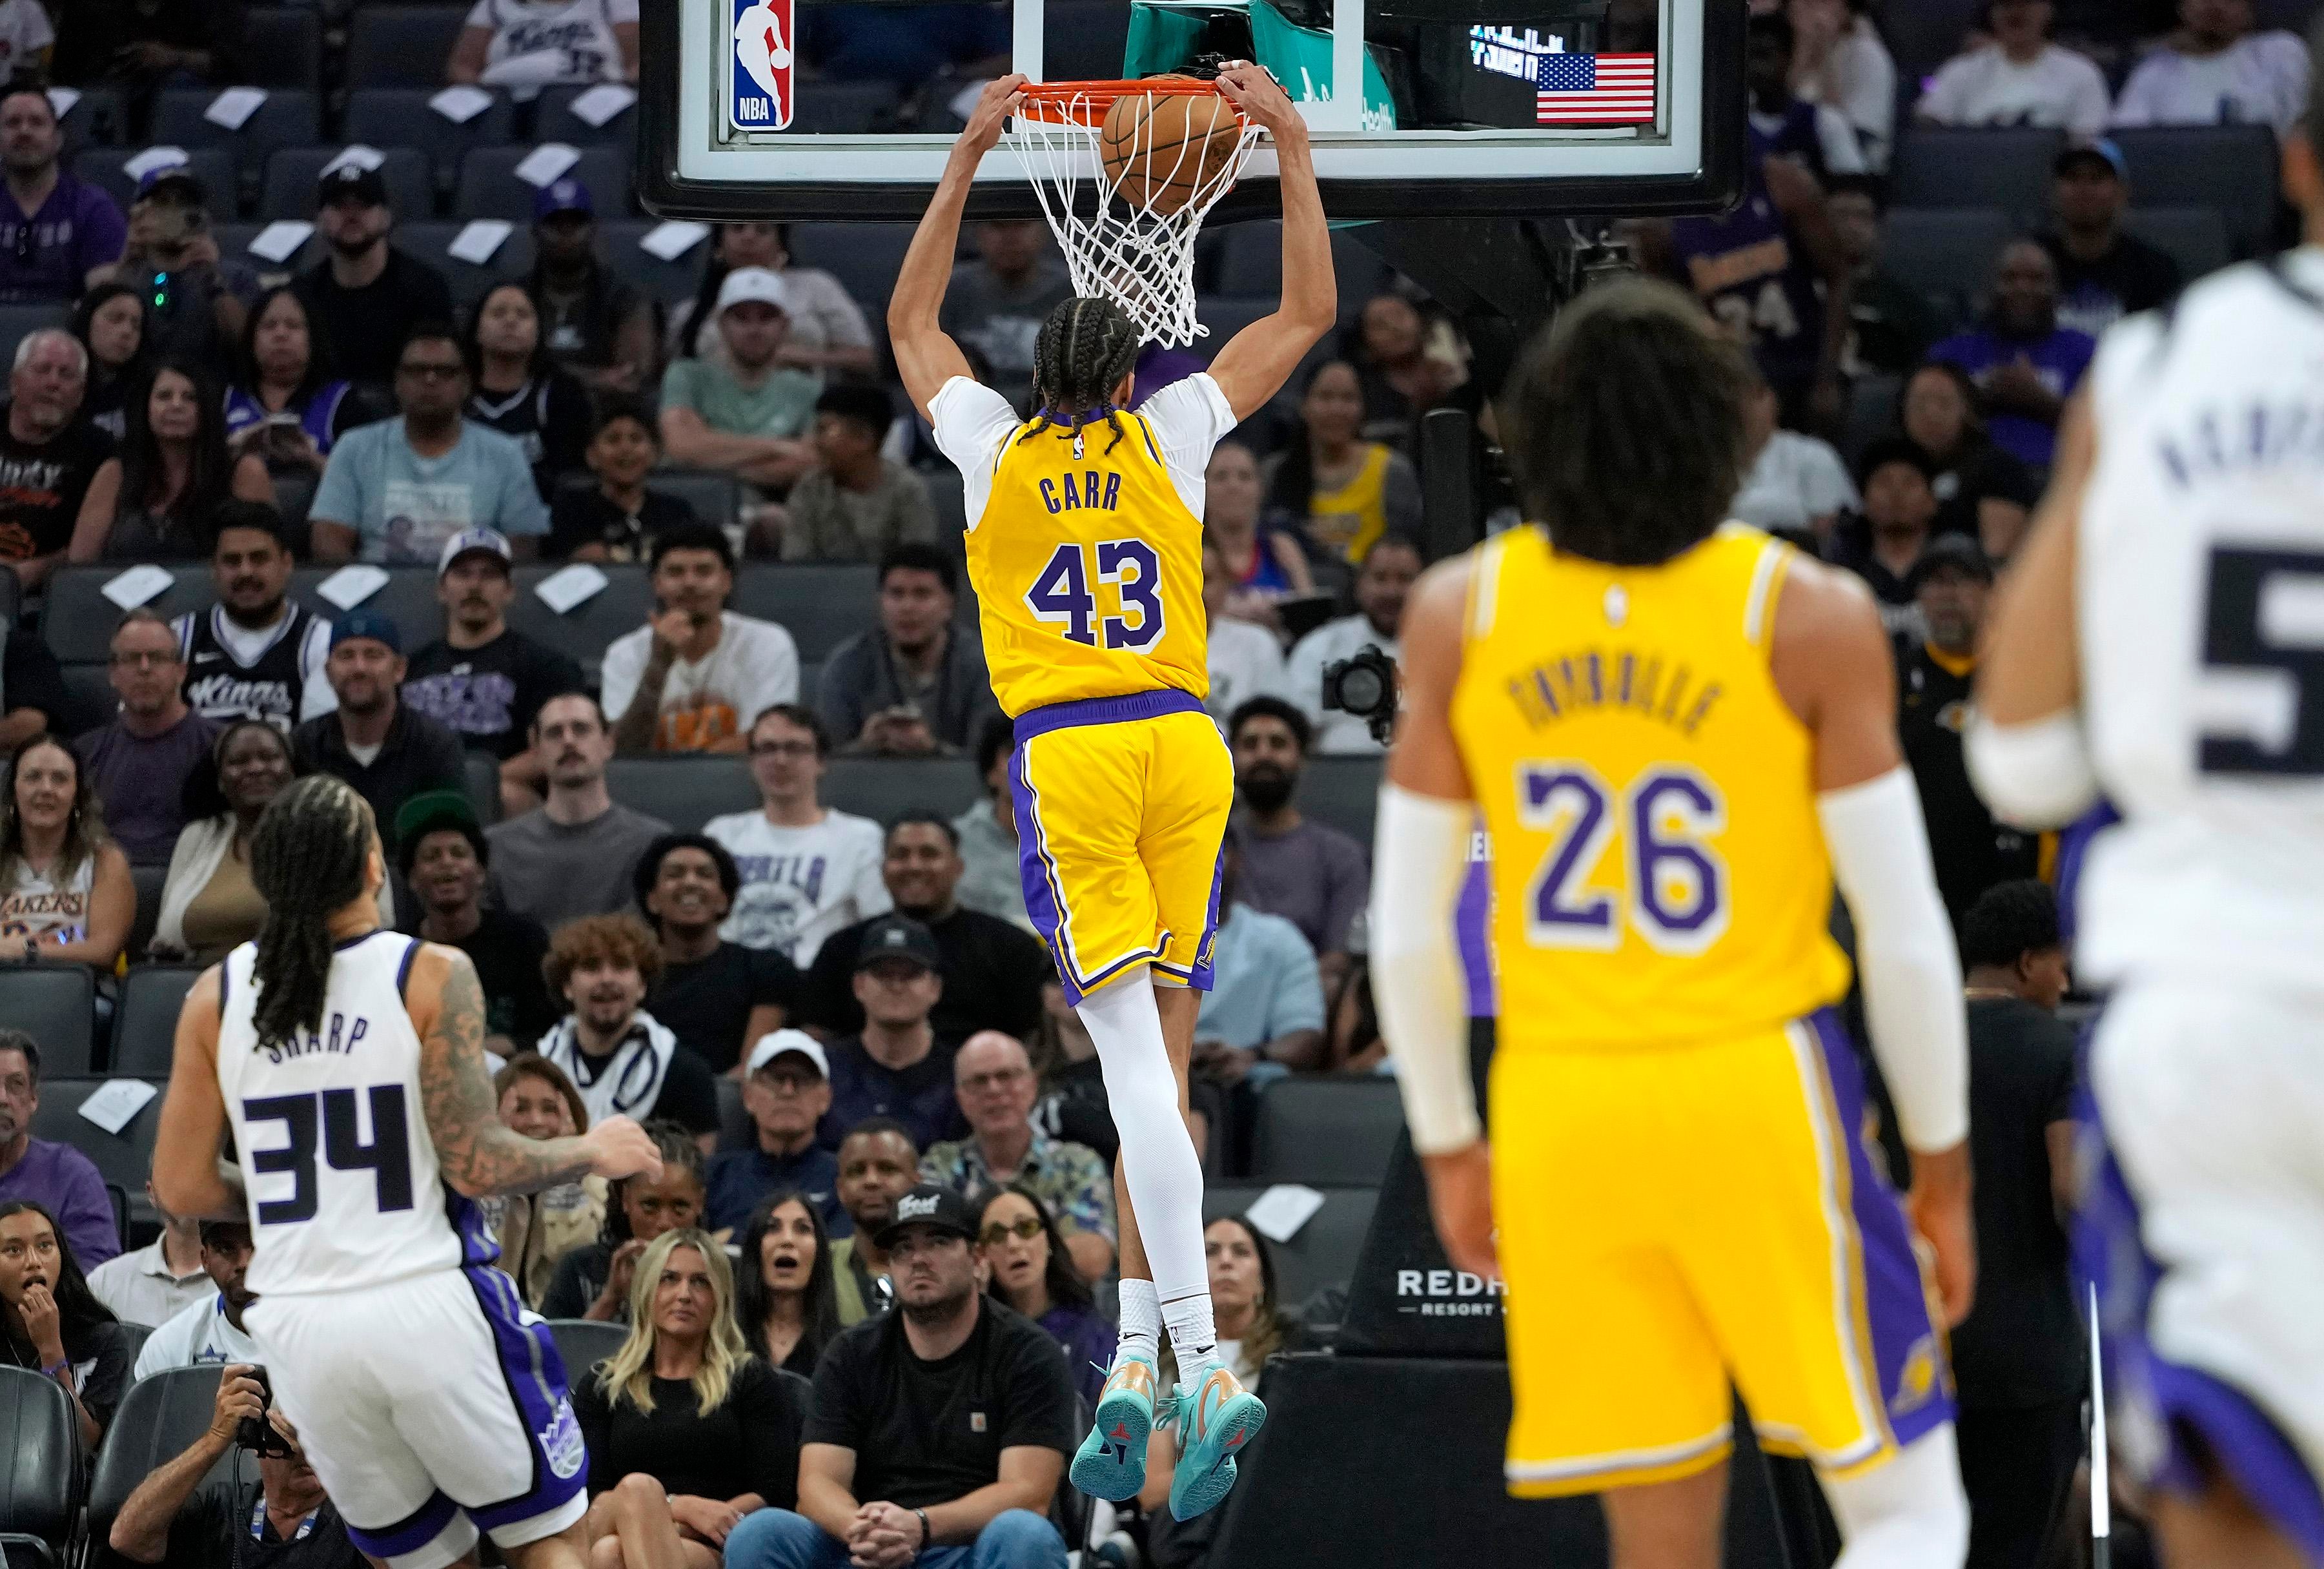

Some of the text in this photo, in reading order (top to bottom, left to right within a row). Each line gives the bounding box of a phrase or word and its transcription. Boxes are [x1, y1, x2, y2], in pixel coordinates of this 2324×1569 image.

[739, 97, 770, 120] NBA
[1039, 470, 1121, 515] CARR
[1023, 537, 1167, 655] 43
[1513, 759, 1733, 957] 26
[1, 892, 83, 917] AKERS
[242, 1083, 414, 1225] 34
[1422, 1302, 1496, 1316] RESORT
